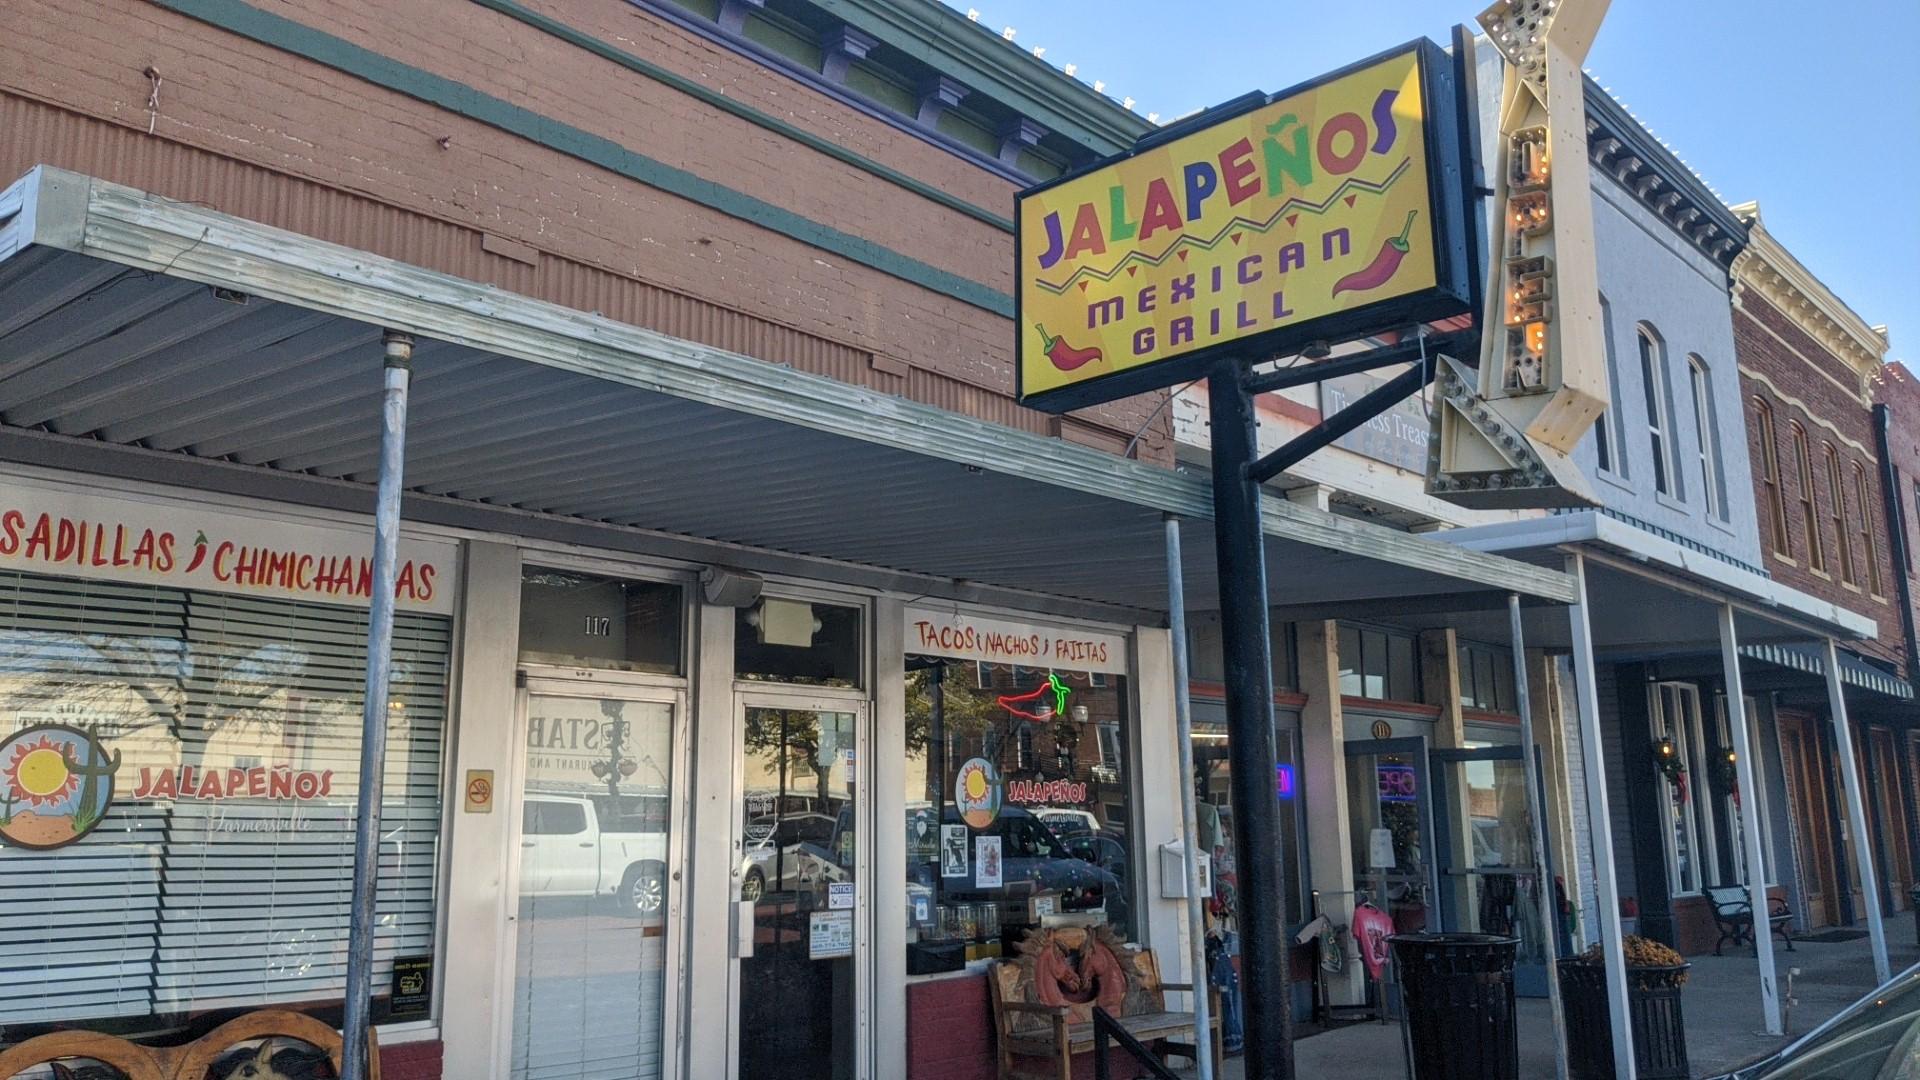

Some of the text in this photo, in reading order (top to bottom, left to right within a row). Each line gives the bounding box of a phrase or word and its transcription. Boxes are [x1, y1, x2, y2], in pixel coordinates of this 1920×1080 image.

[1038, 88, 1399, 269] JALAPEÑOS
[1087, 227, 1351, 329] MEXICAN
[1133, 291, 1294, 355] GRILL
[1392, 413, 1430, 448] Treas
[212, 540, 436, 601] CHIMICHANAS
[585, 616, 610, 636] 117
[914, 621, 1107, 663] TACOS NACHOS FAJITAS
[132, 764, 334, 800] JALAPEÑOS
[1008, 778, 1086, 803] JALAPEÑOS
[830, 884, 853, 893] NOTICE
